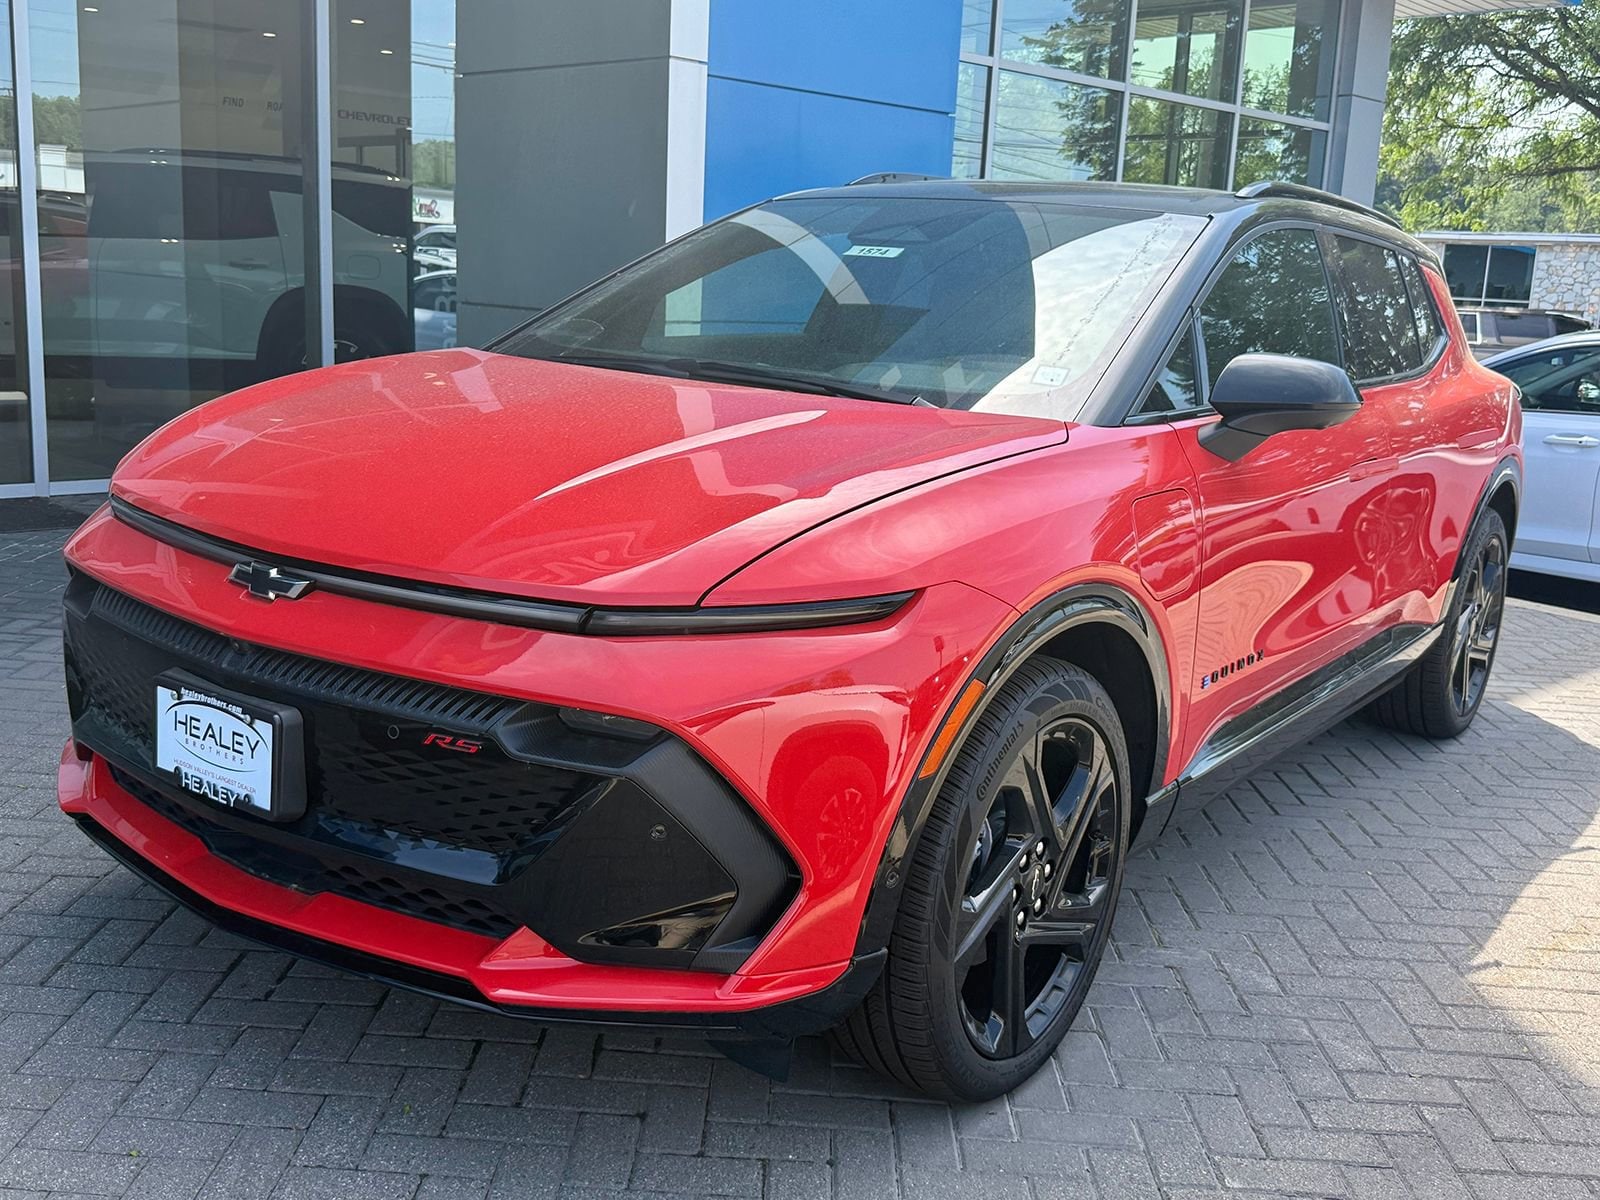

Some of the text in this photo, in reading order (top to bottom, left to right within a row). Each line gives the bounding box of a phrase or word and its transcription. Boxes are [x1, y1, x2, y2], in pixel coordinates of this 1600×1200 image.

[223, 96, 245, 108] FIND
[857, 247, 890, 256] 1574
[1201, 649, 1264, 690] EQUINOX
[181, 687, 243, 715] healeybrothers.com
[174, 710, 260, 759] HEALEY
[423, 733, 483, 754] RS
[185, 738, 244, 765] BROTHERS
[976, 726, 1020, 802] Continental
[182, 773, 238, 808] HEALEY
